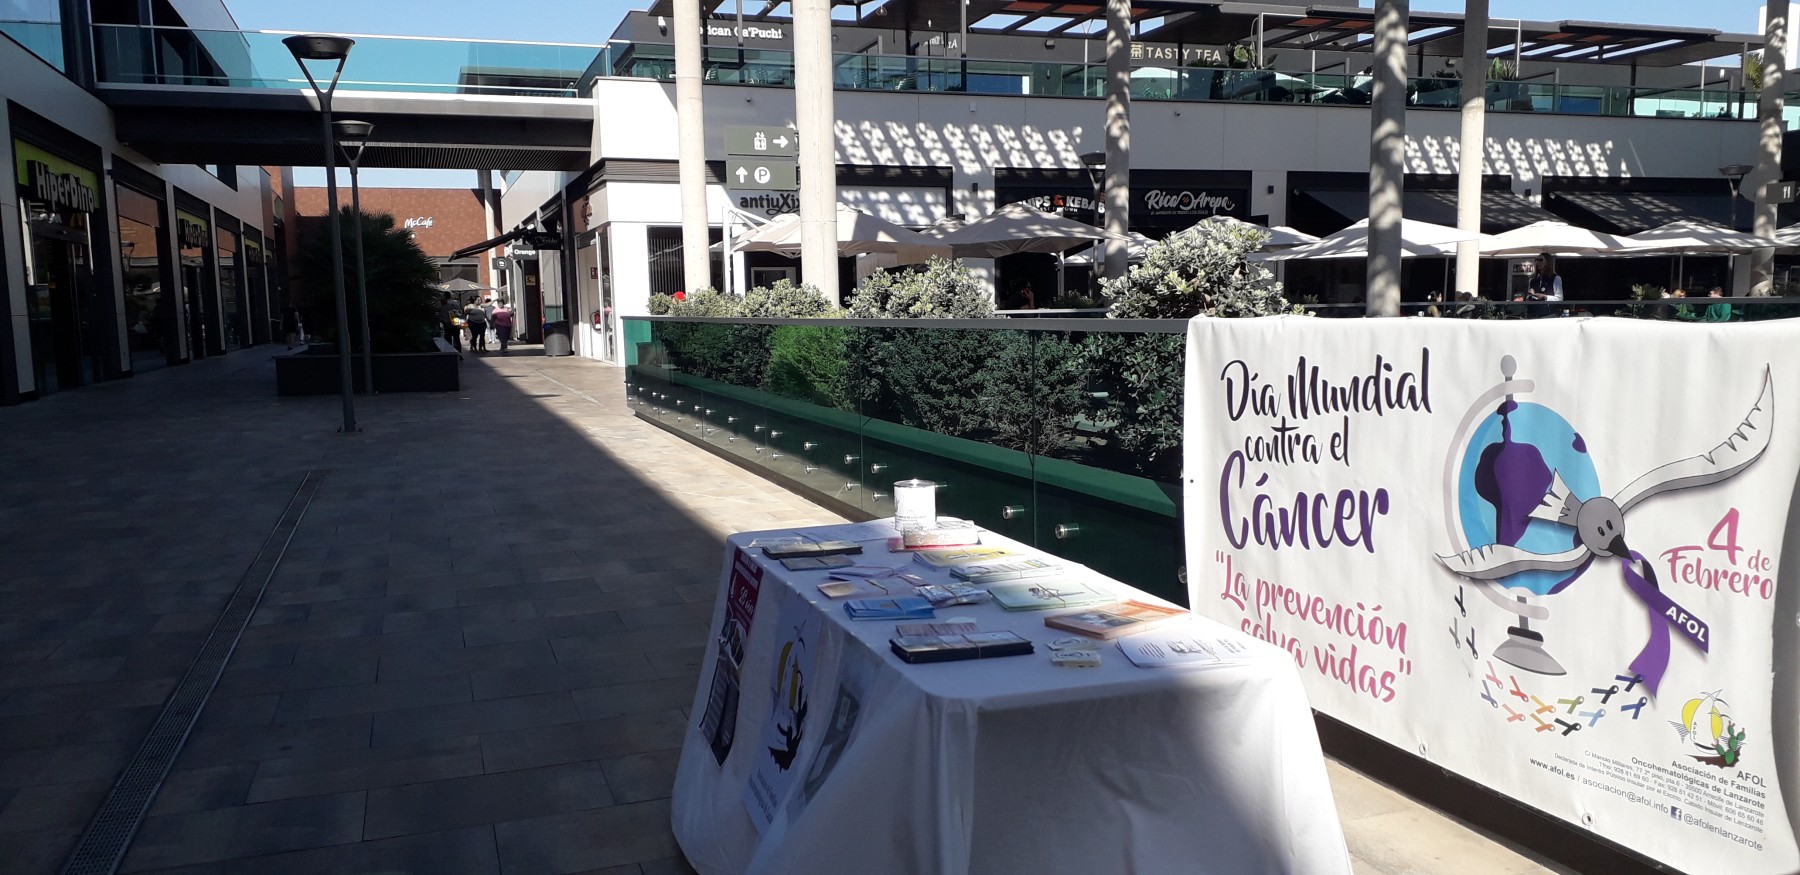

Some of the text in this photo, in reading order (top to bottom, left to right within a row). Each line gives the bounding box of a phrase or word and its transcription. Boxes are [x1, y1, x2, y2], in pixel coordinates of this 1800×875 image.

[1146, 47, 1221, 61] TASTY TEA
[36, 160, 94, 213] HiperDino
[1220, 347, 1432, 422] Día Mundial
[1245, 415, 1350, 467] contra el
[1220, 450, 1390, 554] Cáncer
[1707, 507, 1772, 572] 4 de
[1659, 546, 1773, 600] Febrero
[1216, 550, 1407, 655] "La prevención
[1666, 606, 1706, 642] AFOL
[1314, 642, 1412, 702] vidas"
[1530, 758, 1575, 780] www.afol.es
[1583, 778, 1669, 814] asociacion@afol.info
[1684, 813, 1763, 851] @afolenlanzarote
[1632, 757, 1765, 809] Oncohematológicas de Lanzarote
[1672, 760, 1766, 799] Asociación de Familias
[1737, 770, 1766, 788] AFOL
[1733, 817, 1763, 834] Lanzarote
[1735, 802, 1764, 818] Lanzarote
